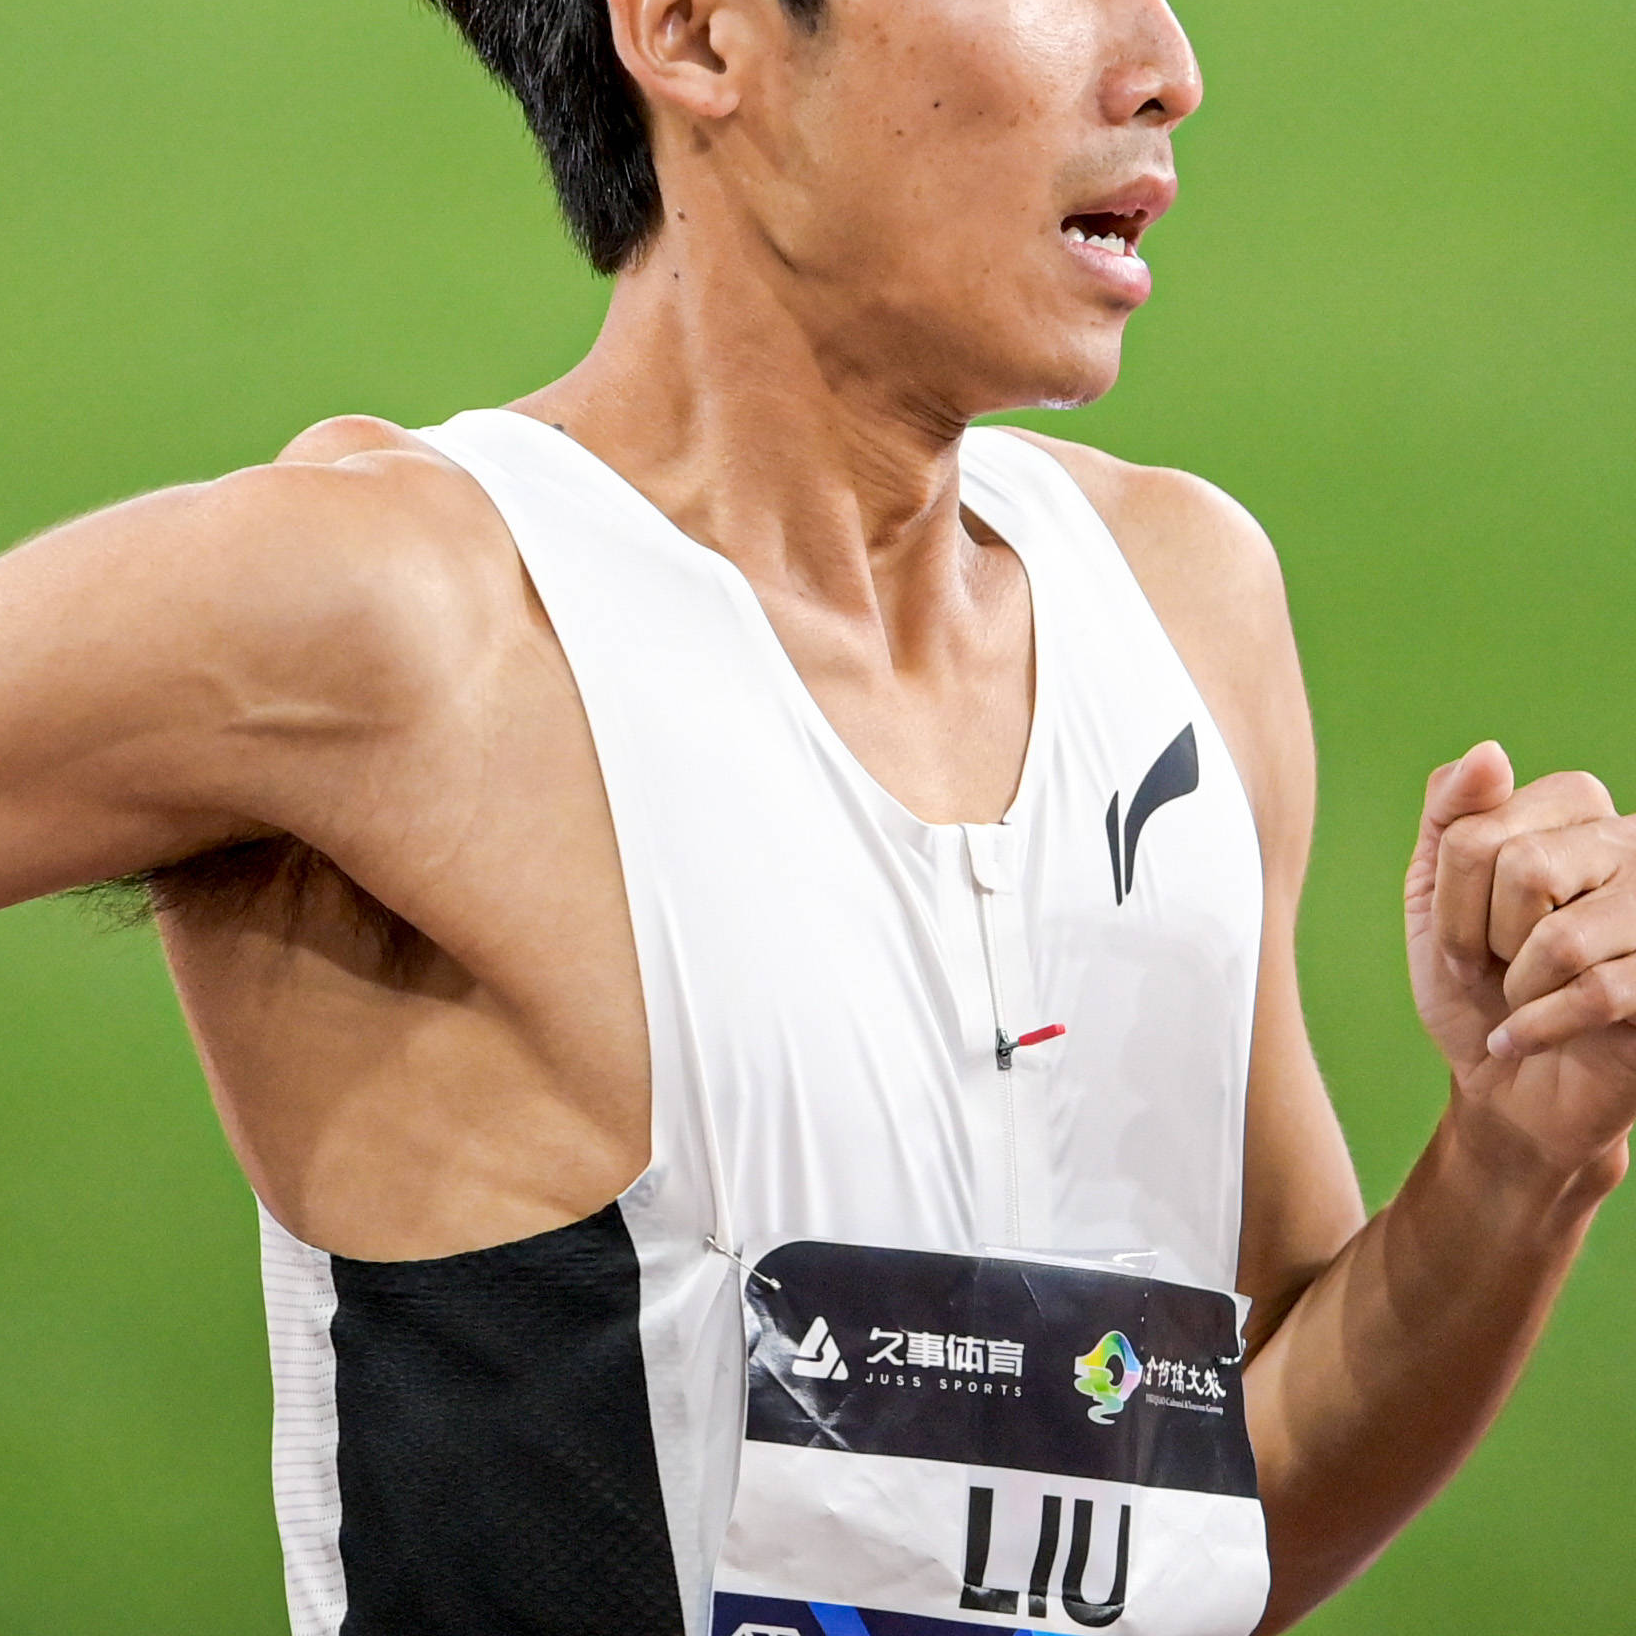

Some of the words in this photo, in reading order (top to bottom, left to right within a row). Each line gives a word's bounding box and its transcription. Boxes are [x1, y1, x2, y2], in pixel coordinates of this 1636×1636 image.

[866, 1327, 1024, 1377] 久事体育
[865, 1373, 921, 1387] JUSS
[939, 1378, 1021, 1397] SPORTS
[959, 1486, 1131, 1627] LIU
